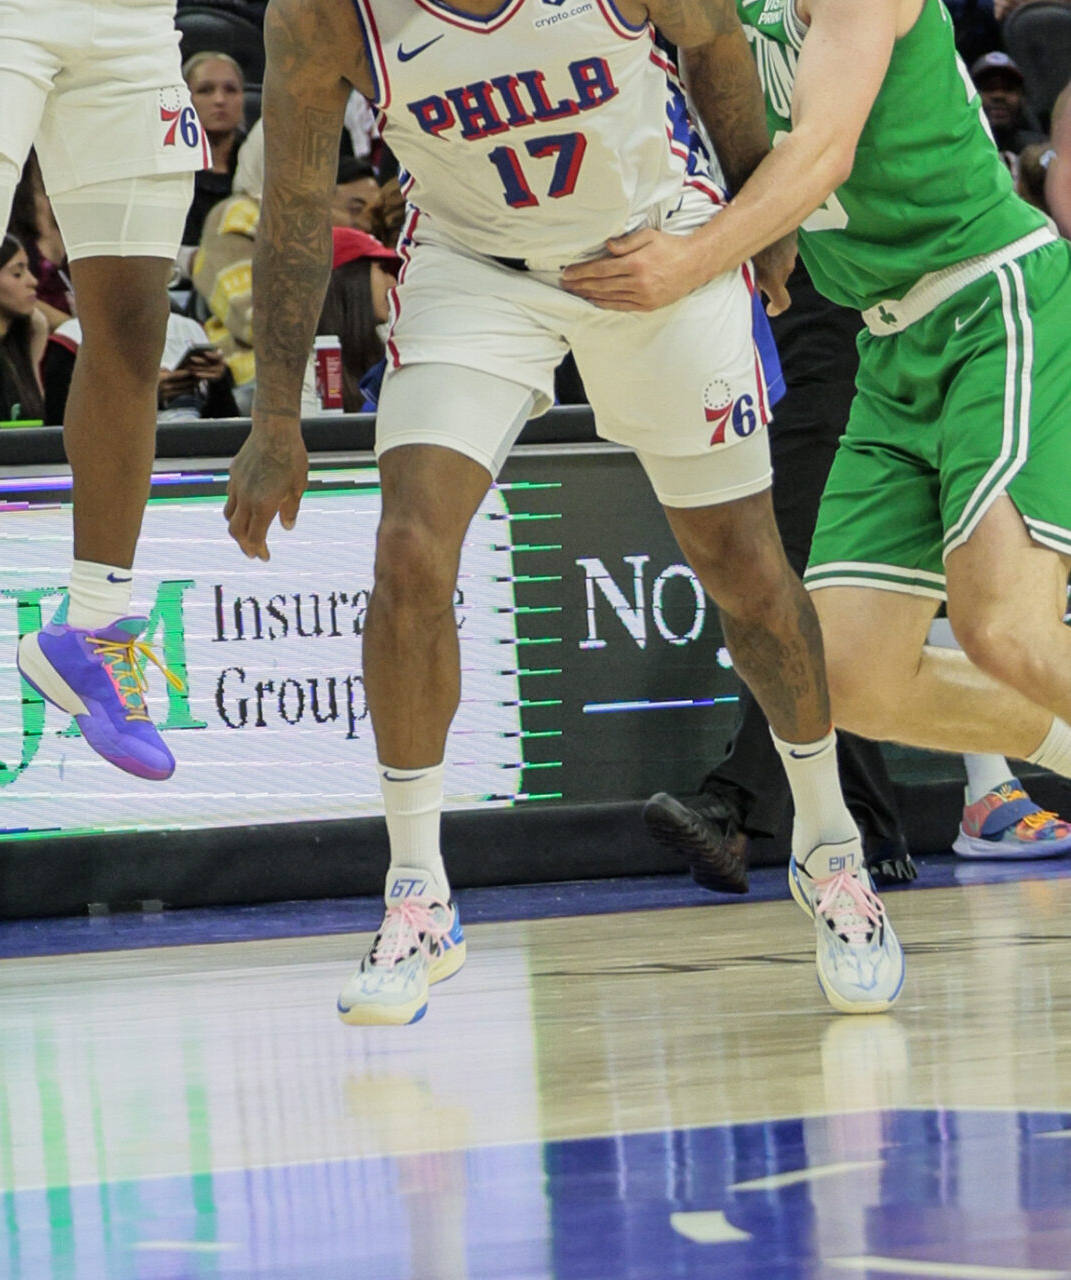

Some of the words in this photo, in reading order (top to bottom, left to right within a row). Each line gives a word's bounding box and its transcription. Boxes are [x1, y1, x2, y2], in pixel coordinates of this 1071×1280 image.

[535, 3, 593, 28] crypto.com
[160, 105, 198, 148] 76
[407, 57, 619, 142] PHILA
[488, 132, 587, 209] 17
[704, 394, 757, 446] 76
[212, 584, 466, 641] Insura
[215, 667, 369, 739] Group
